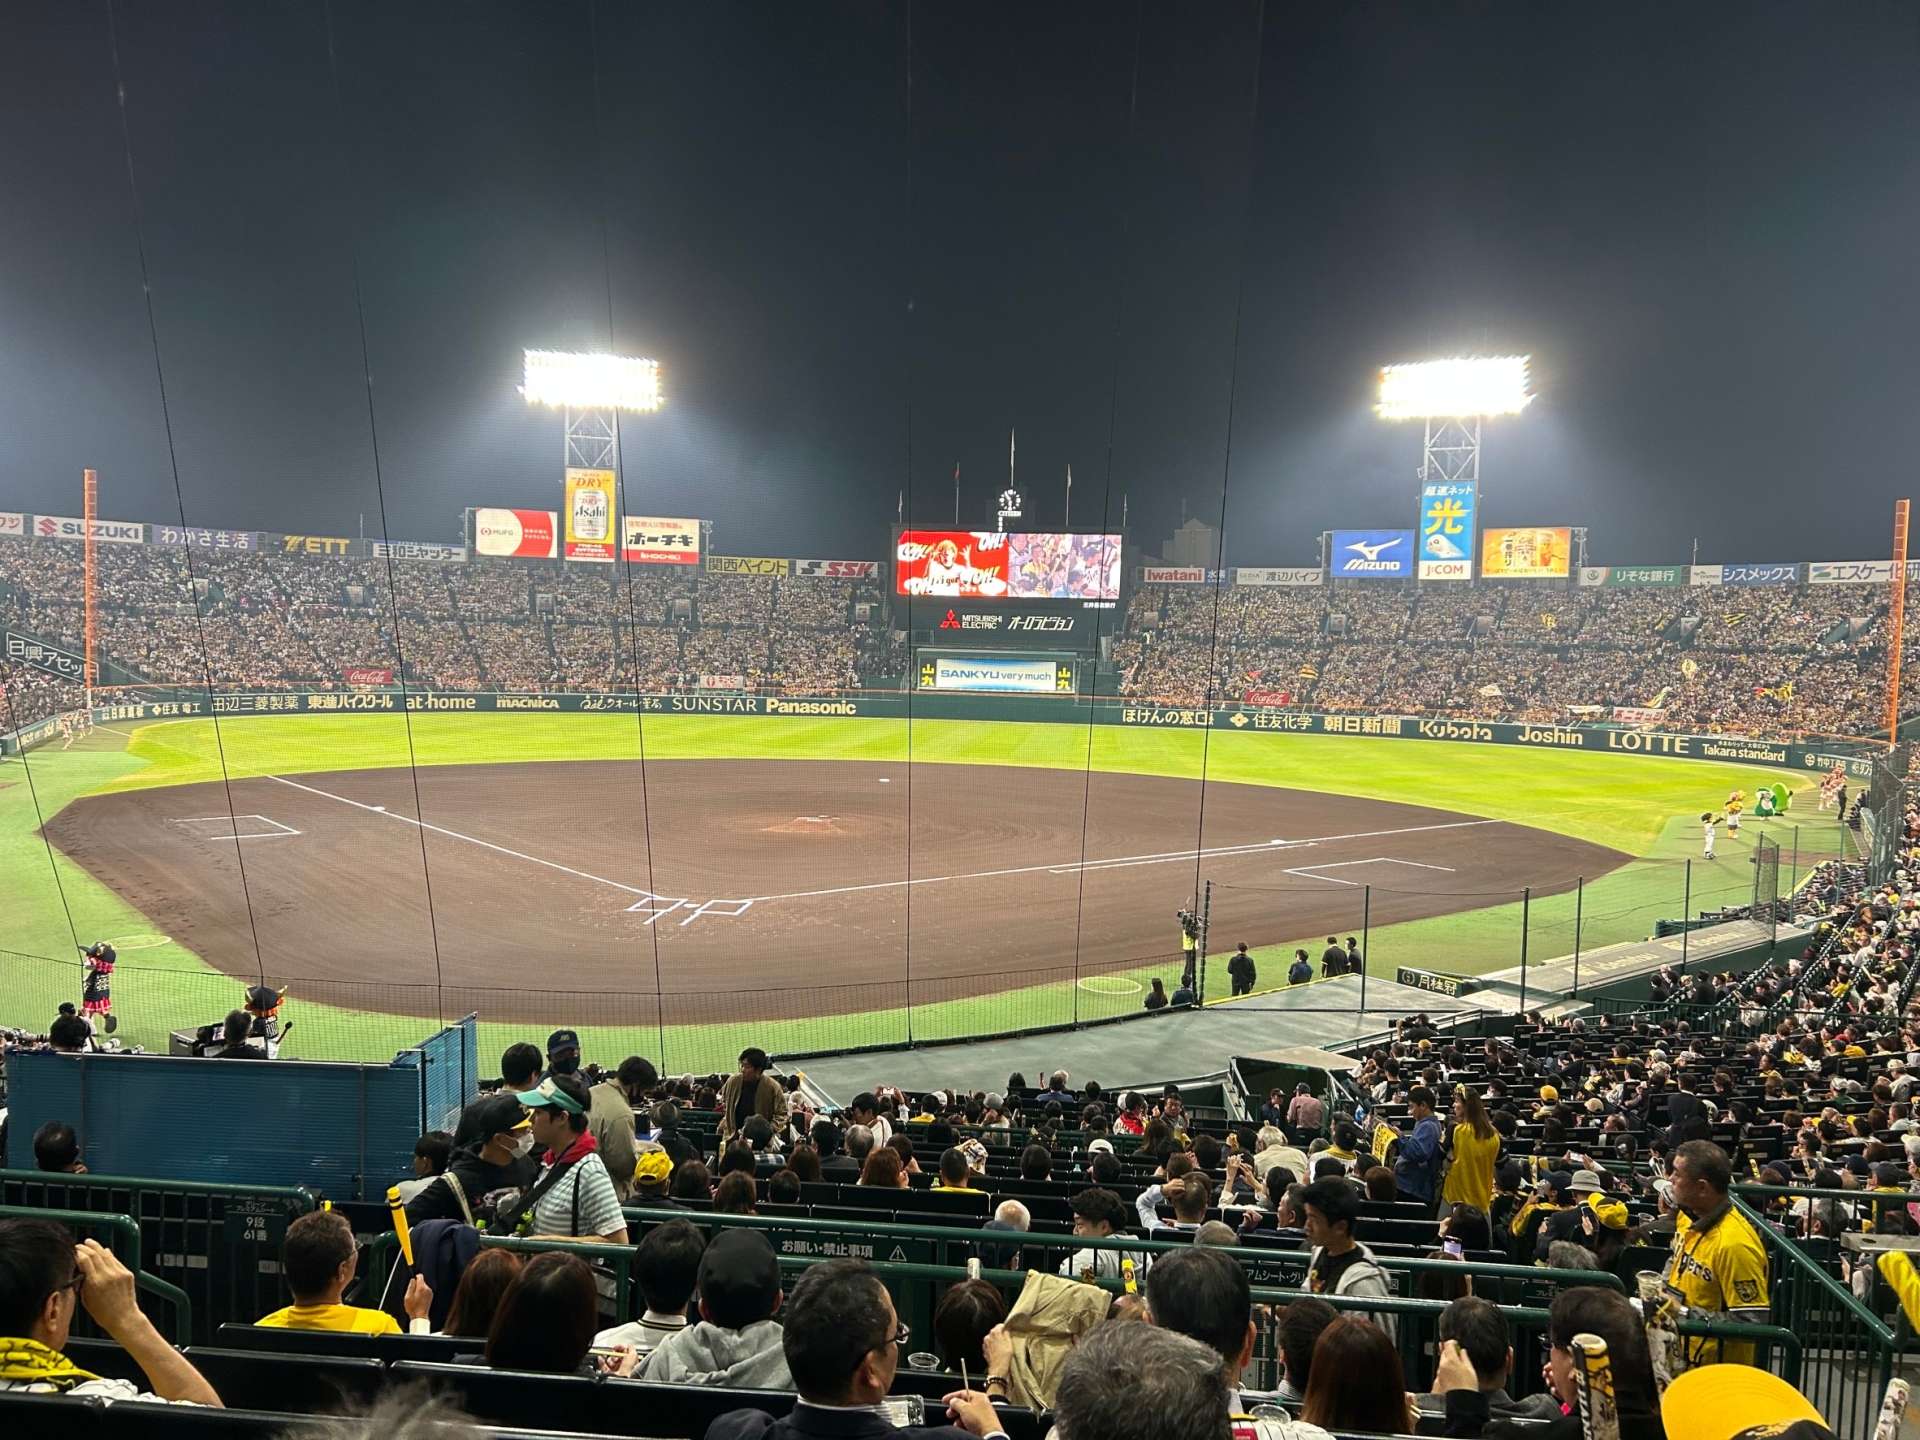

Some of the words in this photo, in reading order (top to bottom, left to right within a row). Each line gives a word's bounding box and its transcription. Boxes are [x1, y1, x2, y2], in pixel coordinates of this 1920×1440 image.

[575, 505, 606, 518] Asahi
[1424, 498, 1472, 535] 光
[62, 522, 139, 540] SUZUKI
[162, 527, 249, 550] わかさ生活
[628, 533, 693, 546] ホーチキ
[708, 557, 787, 576] 関西ペイント
[826, 561, 875, 577] SSK
[1425, 564, 1464, 576] J:COM
[1724, 568, 1795, 581] シスメックス
[1148, 569, 1202, 581] Iwatani
[1616, 569, 1676, 583] りそな銀行
[962, 615, 1002, 623] MITSUBISHI
[1008, 616, 1074, 631] オーロラビジョン
[941, 669, 999, 678] SANKYU
[1001, 672, 1023, 681] very
[1024, 673, 1051, 681] much
[212, 696, 299, 712] 田辺三菱製薬
[308, 694, 393, 709] 東進ハイスクール
[406, 697, 423, 709] at
[427, 694, 476, 709] home
[672, 698, 757, 712] SUNSTAR
[766, 699, 857, 715] Panasonic
[1122, 709, 1209, 725] ほけんの窓口
[1252, 713, 1312, 730] 住友化学
[1324, 716, 1401, 734] 朝日新聞
[1419, 721, 1492, 741] Kubota
[1518, 727, 1583, 745] Joshin
[1609, 732, 1689, 753] LOTTE
[1702, 744, 1737, 757] Takara
[1738, 748, 1785, 762] standard
[782, 1240, 873, 1258] お願い・禁止事項
